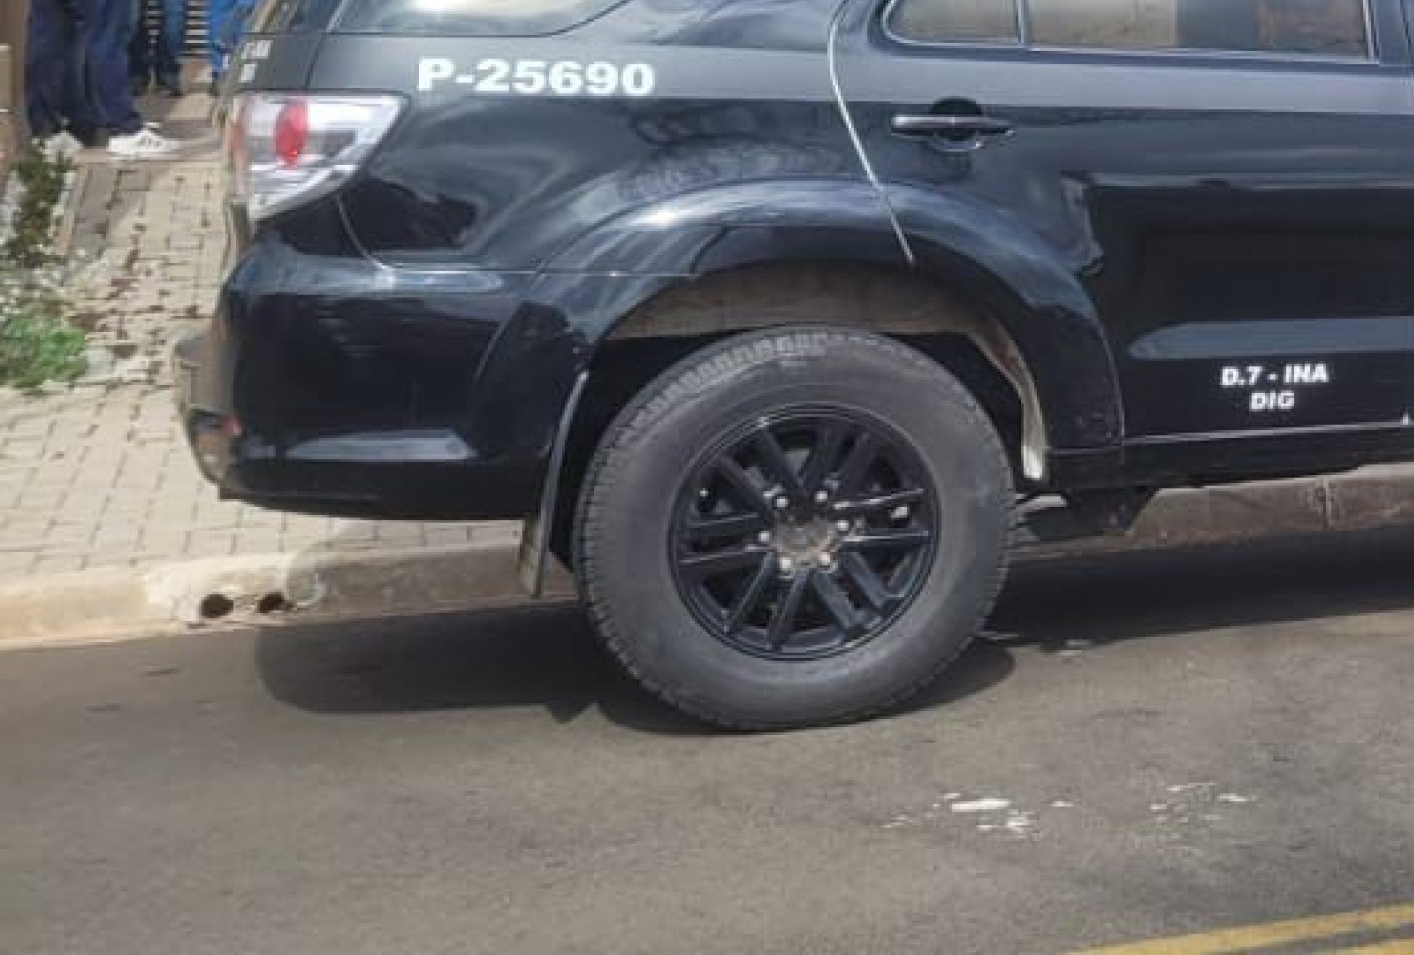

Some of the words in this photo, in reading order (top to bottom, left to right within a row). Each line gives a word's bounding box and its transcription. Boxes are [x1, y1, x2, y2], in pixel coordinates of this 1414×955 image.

[416, 57, 656, 97] P-25690
[1221, 364, 1264, 387] D.7
[1283, 363, 1330, 384] INA
[1248, 390, 1296, 411] DIG
